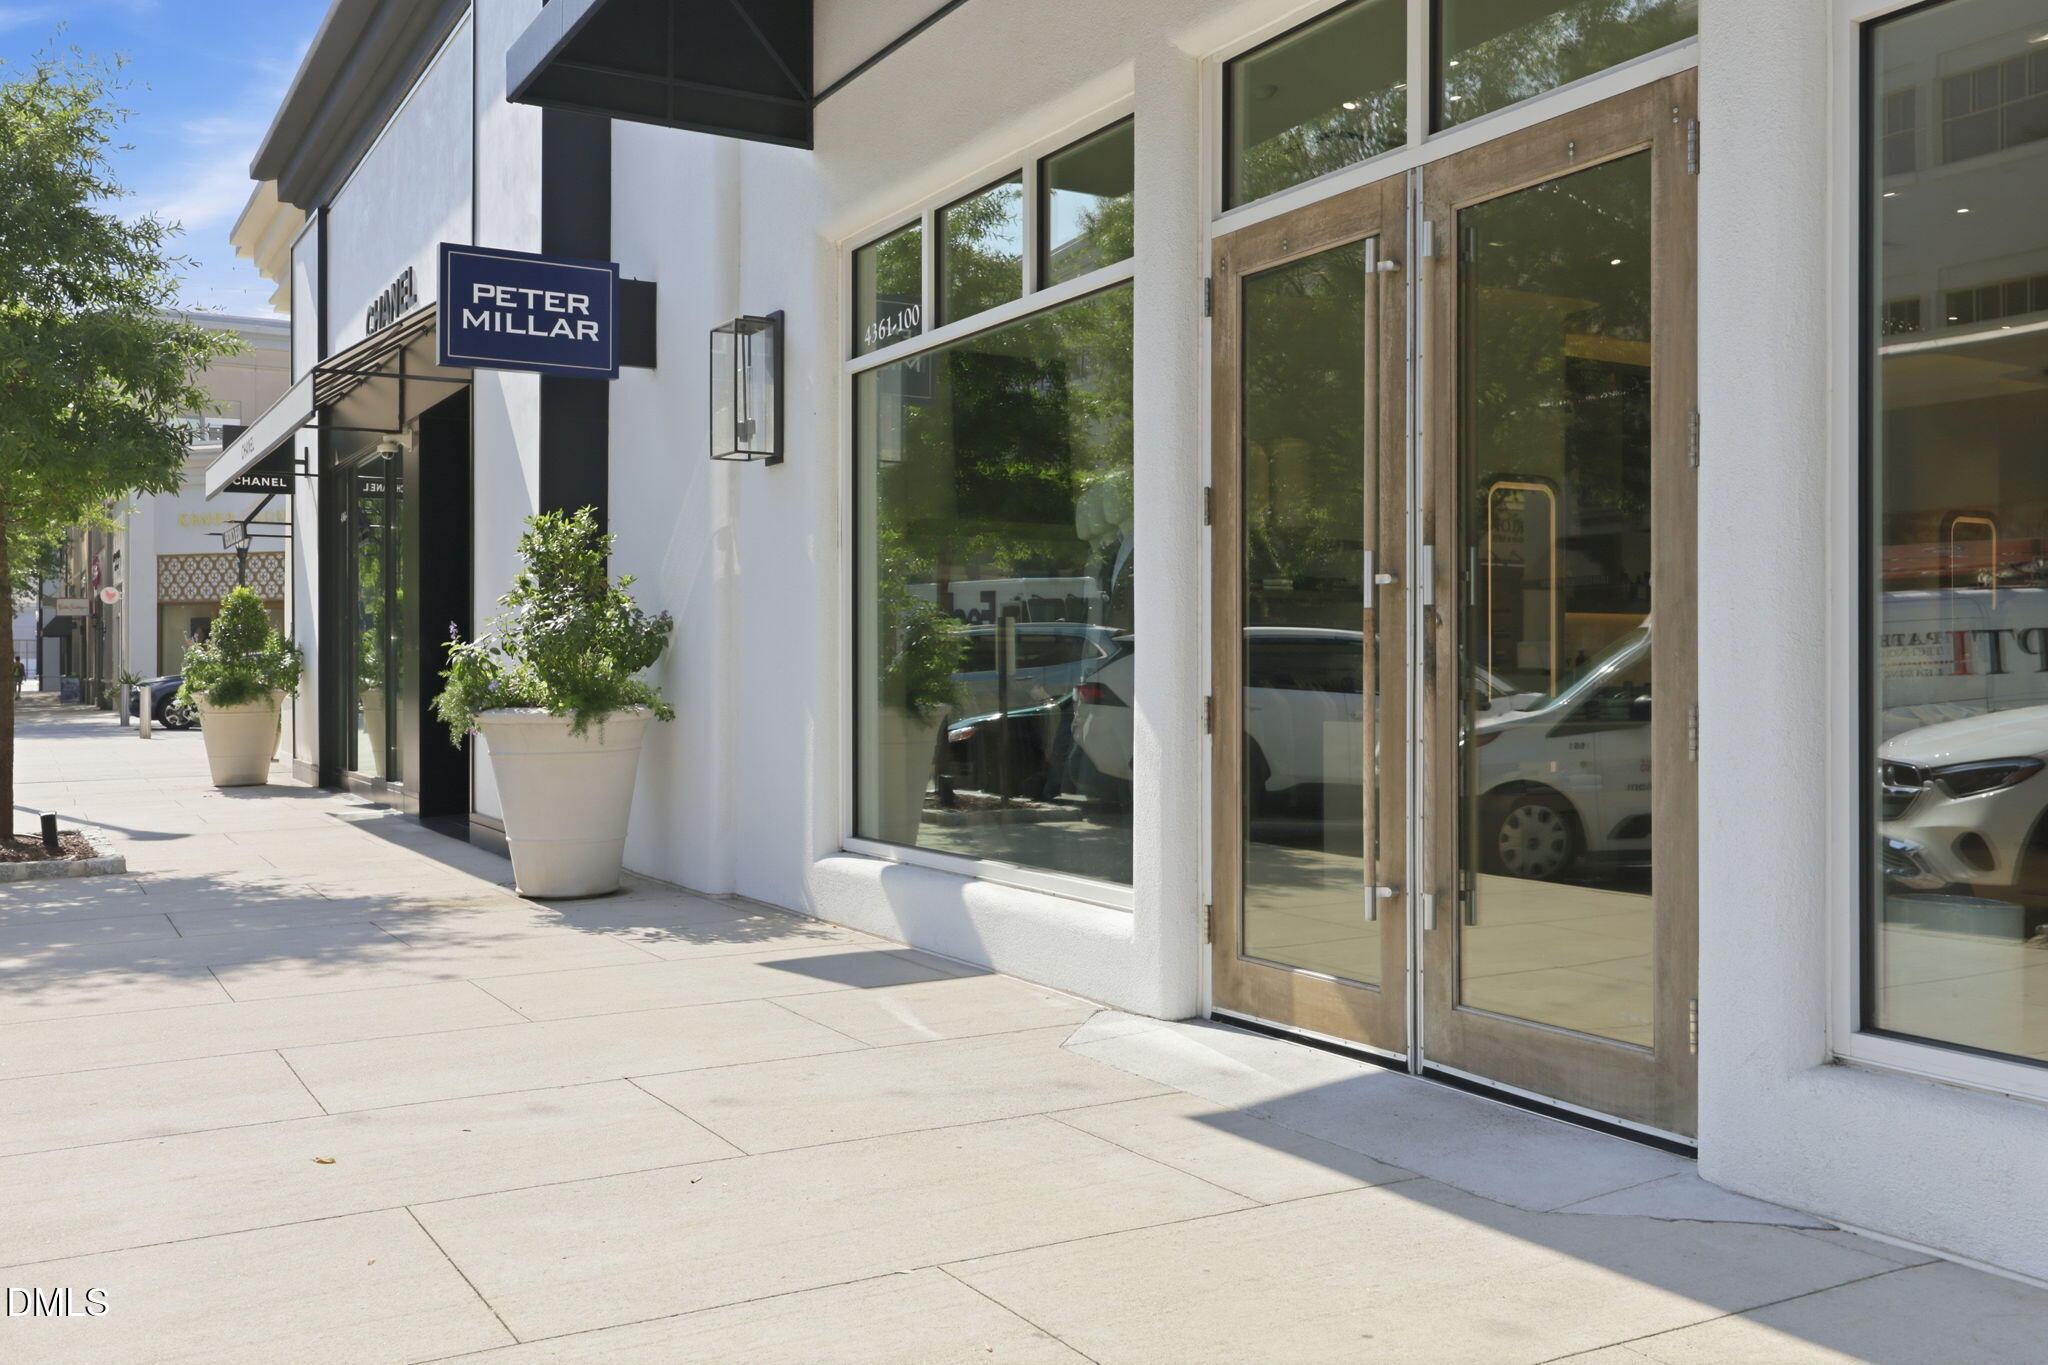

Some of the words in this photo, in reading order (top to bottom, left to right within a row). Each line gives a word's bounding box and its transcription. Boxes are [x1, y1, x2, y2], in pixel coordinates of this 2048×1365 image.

[365, 266, 418, 336] CHANEL
[472, 283, 590, 316] PETER
[462, 308, 600, 342] MILLAR
[864, 304, 920, 346] 4361-100
